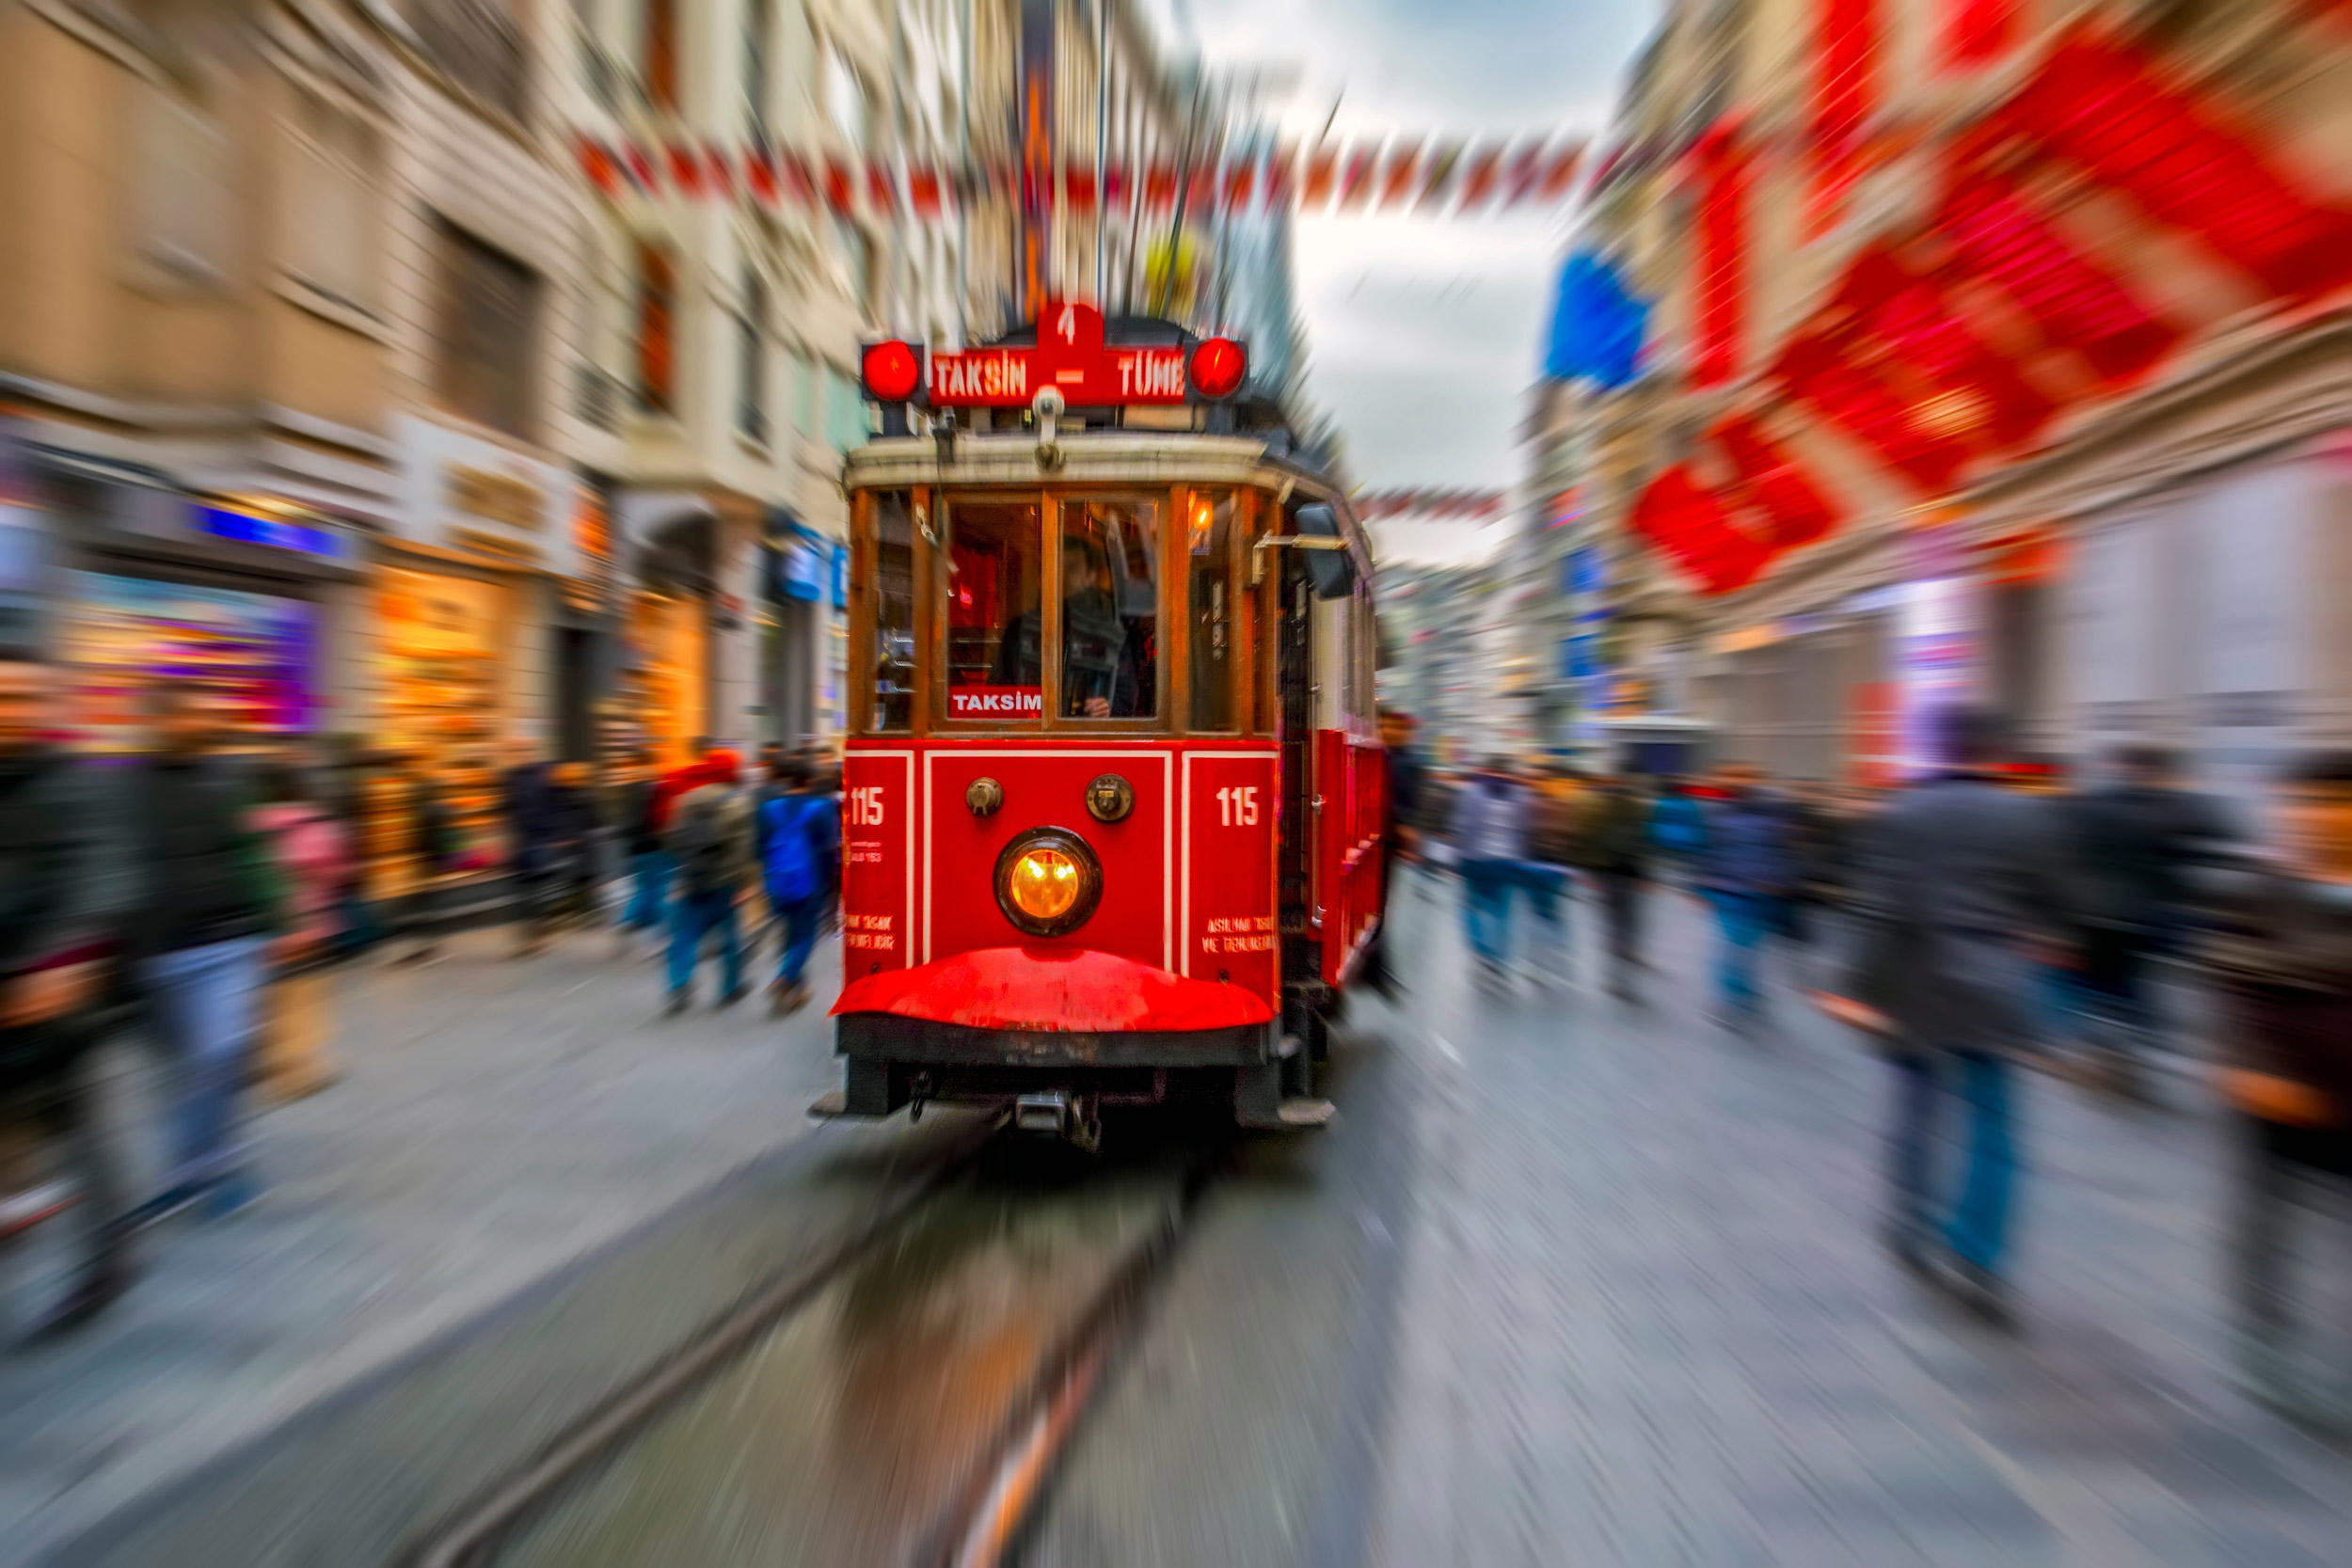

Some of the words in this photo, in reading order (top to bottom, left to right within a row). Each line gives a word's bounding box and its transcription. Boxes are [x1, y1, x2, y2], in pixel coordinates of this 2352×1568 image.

[952, 689, 1041, 711] TAKSİM
[850, 786, 884, 826] 115
[1216, 785, 1260, 827] 115
